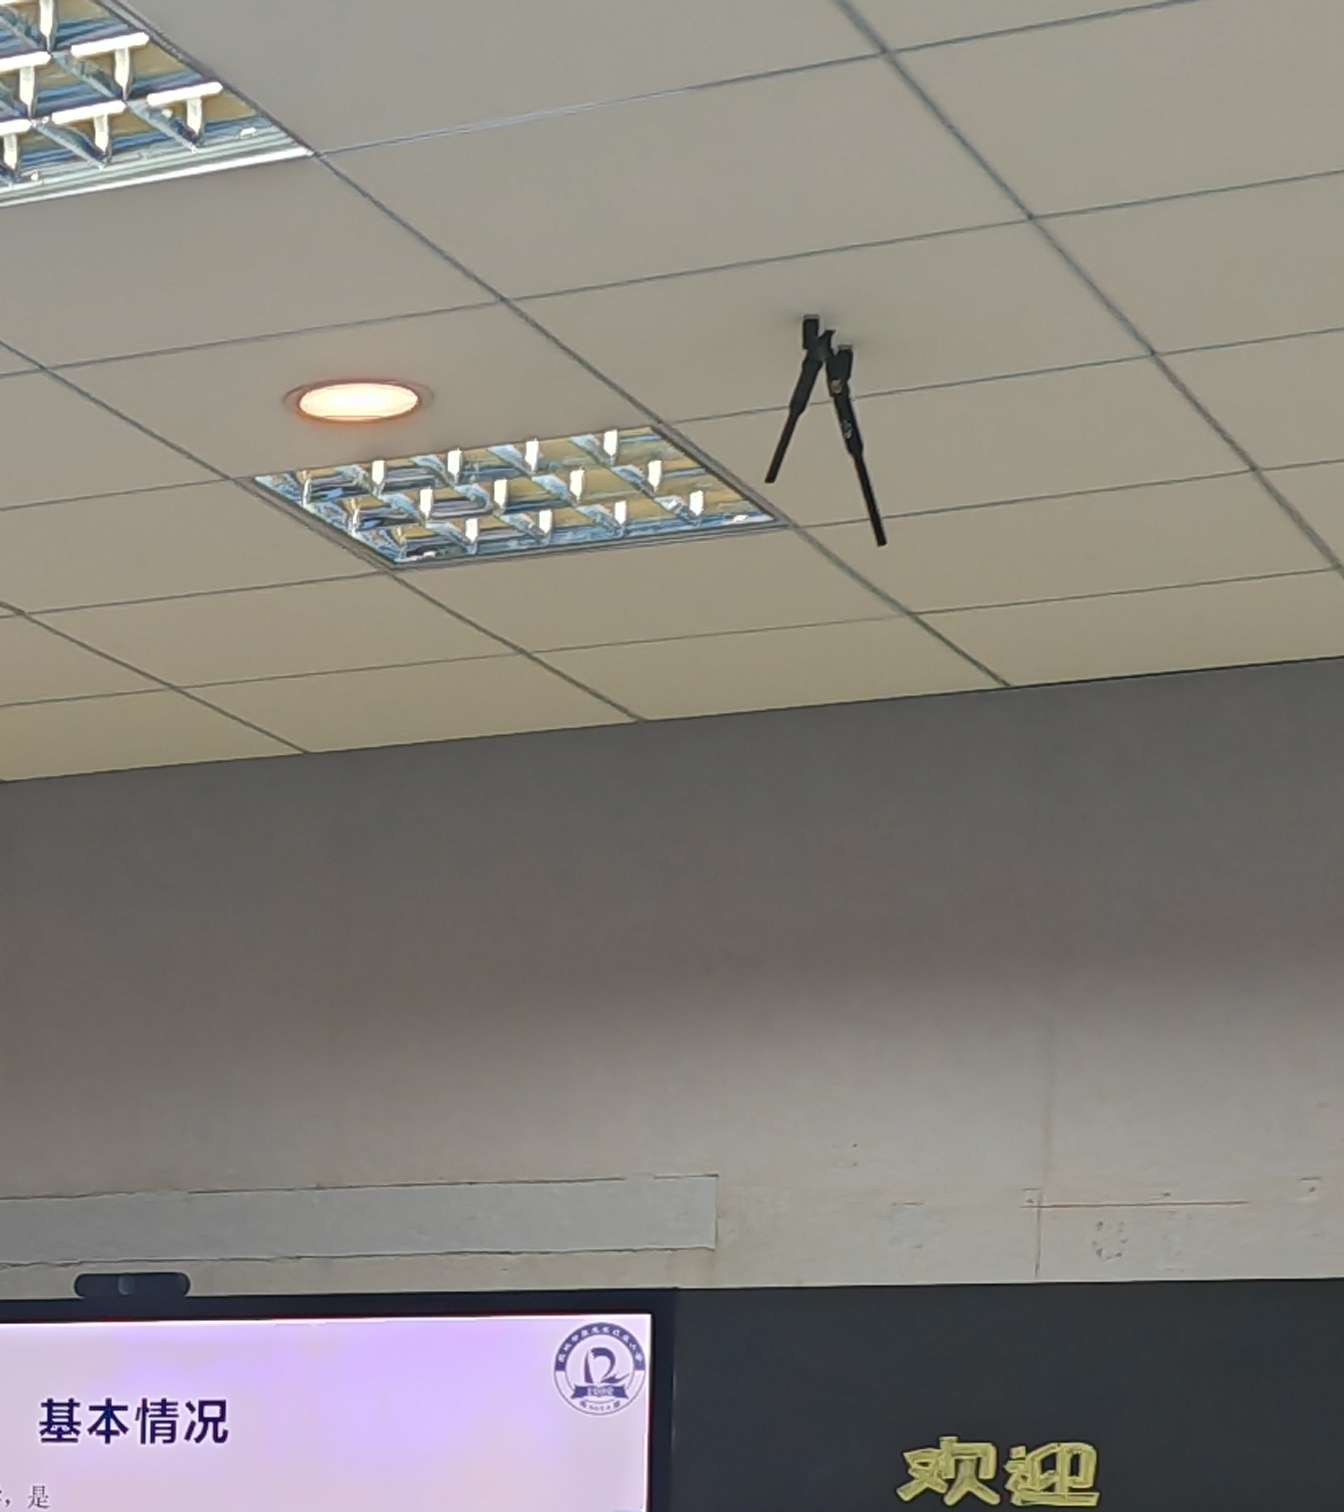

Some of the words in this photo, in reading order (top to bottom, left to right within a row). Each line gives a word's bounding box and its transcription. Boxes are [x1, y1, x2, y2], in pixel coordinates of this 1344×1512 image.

[38, 1398, 230, 1447] 基本情况
[897, 1436, 1100, 1506] 欢迎
